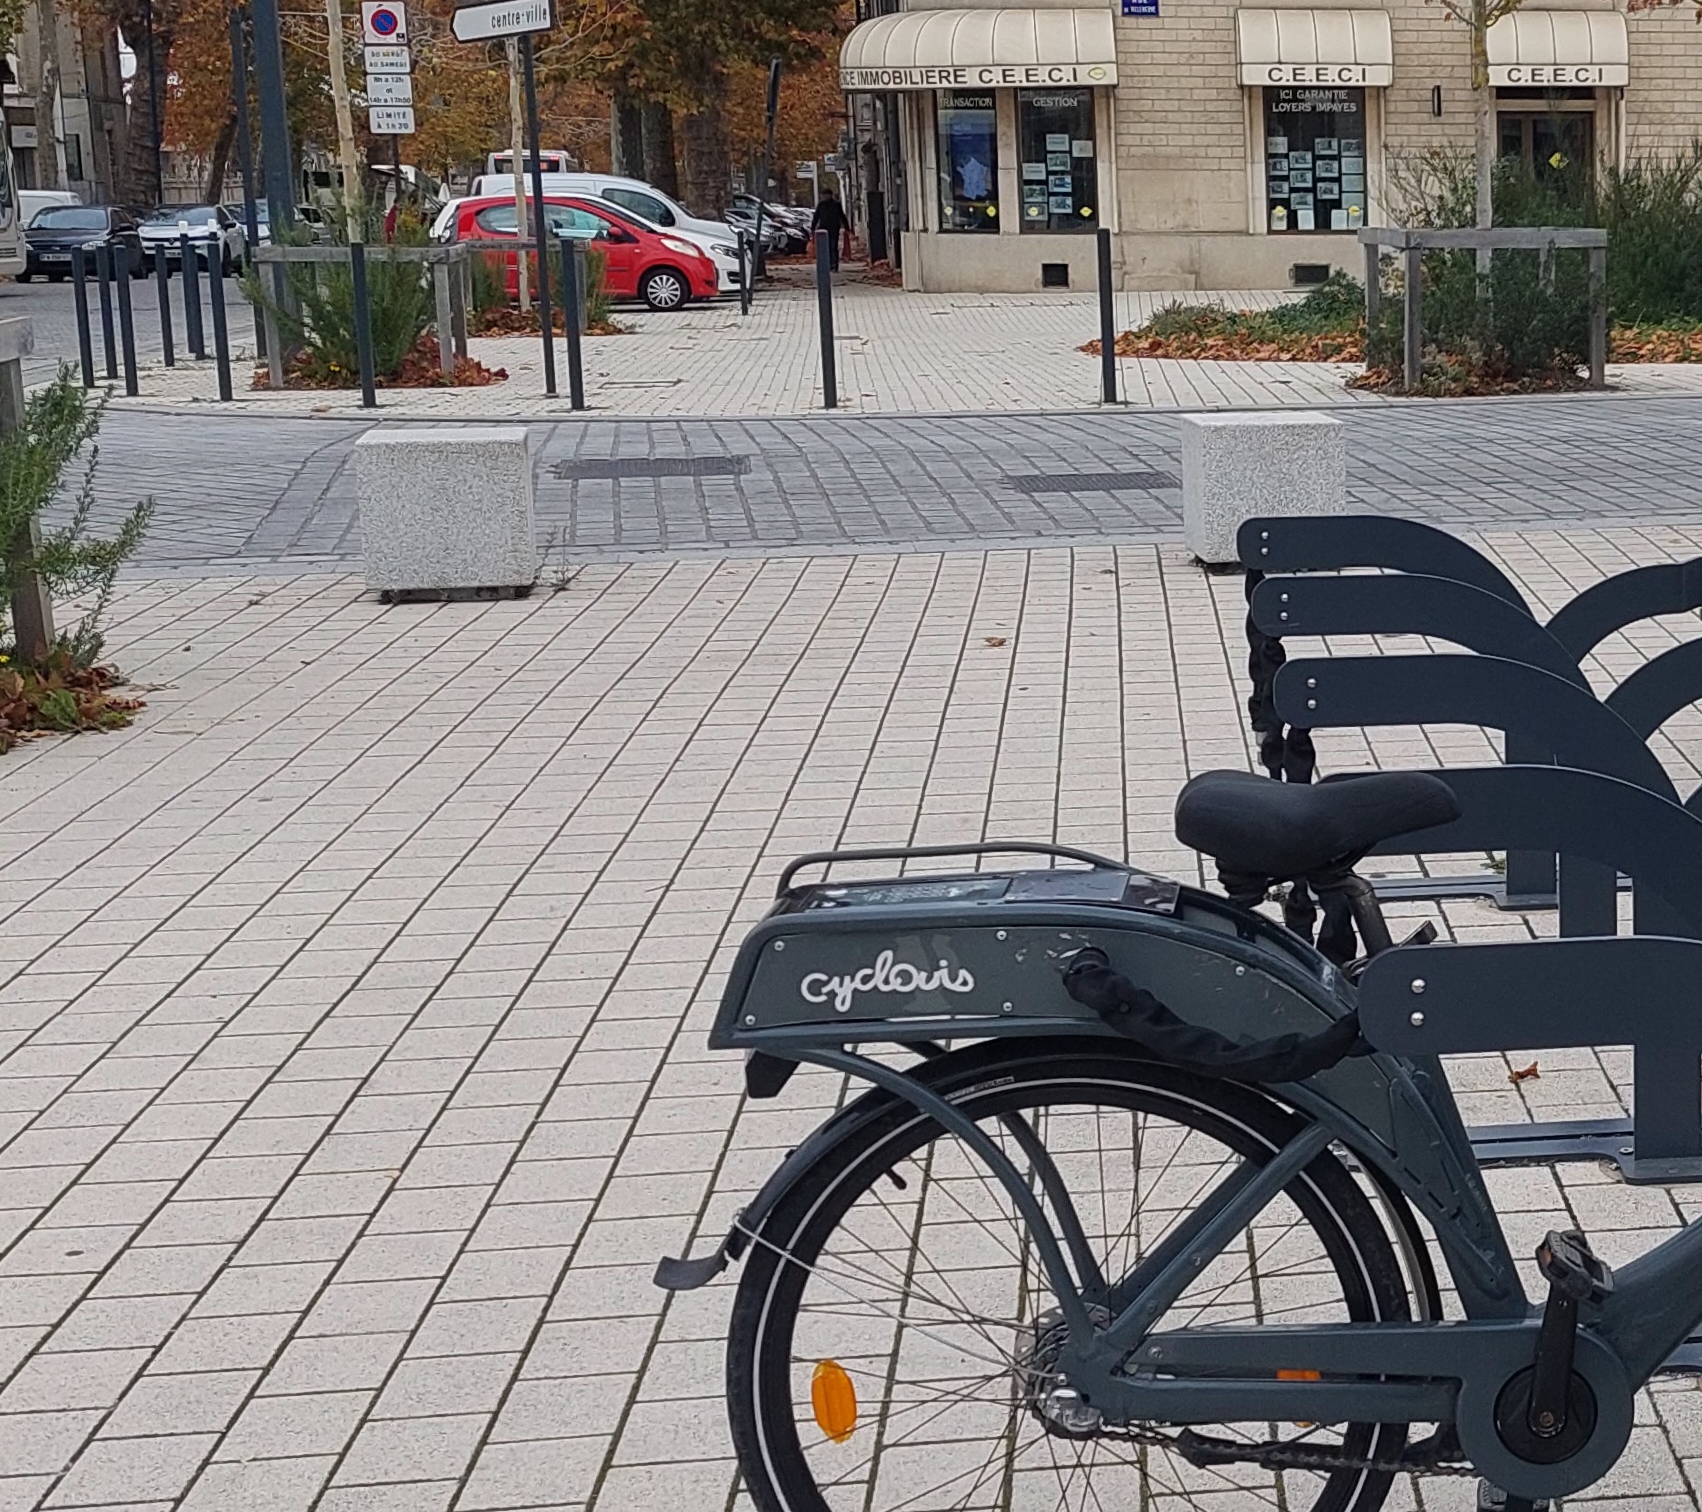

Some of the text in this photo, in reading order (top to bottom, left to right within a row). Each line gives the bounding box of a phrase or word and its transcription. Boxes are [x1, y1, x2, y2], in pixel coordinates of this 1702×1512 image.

[491, 4, 547, 28] centre-ville
[857, 68, 968, 86] IMMOBILIERE
[978, 67, 1079, 85] C.E.E.C.I
[1267, 67, 1367, 83] C.E.E.C.I
[1506, 67, 1604, 84] C.E.E.C.I
[940, 97, 993, 108] TRANSACTION
[1033, 96, 1078, 107] GESTION
[1280, 89, 1348, 100] ICI GARANTIE
[1272, 102, 1357, 113] LOYERS IMPAYES
[800, 949, 975, 1013] cyclovis
